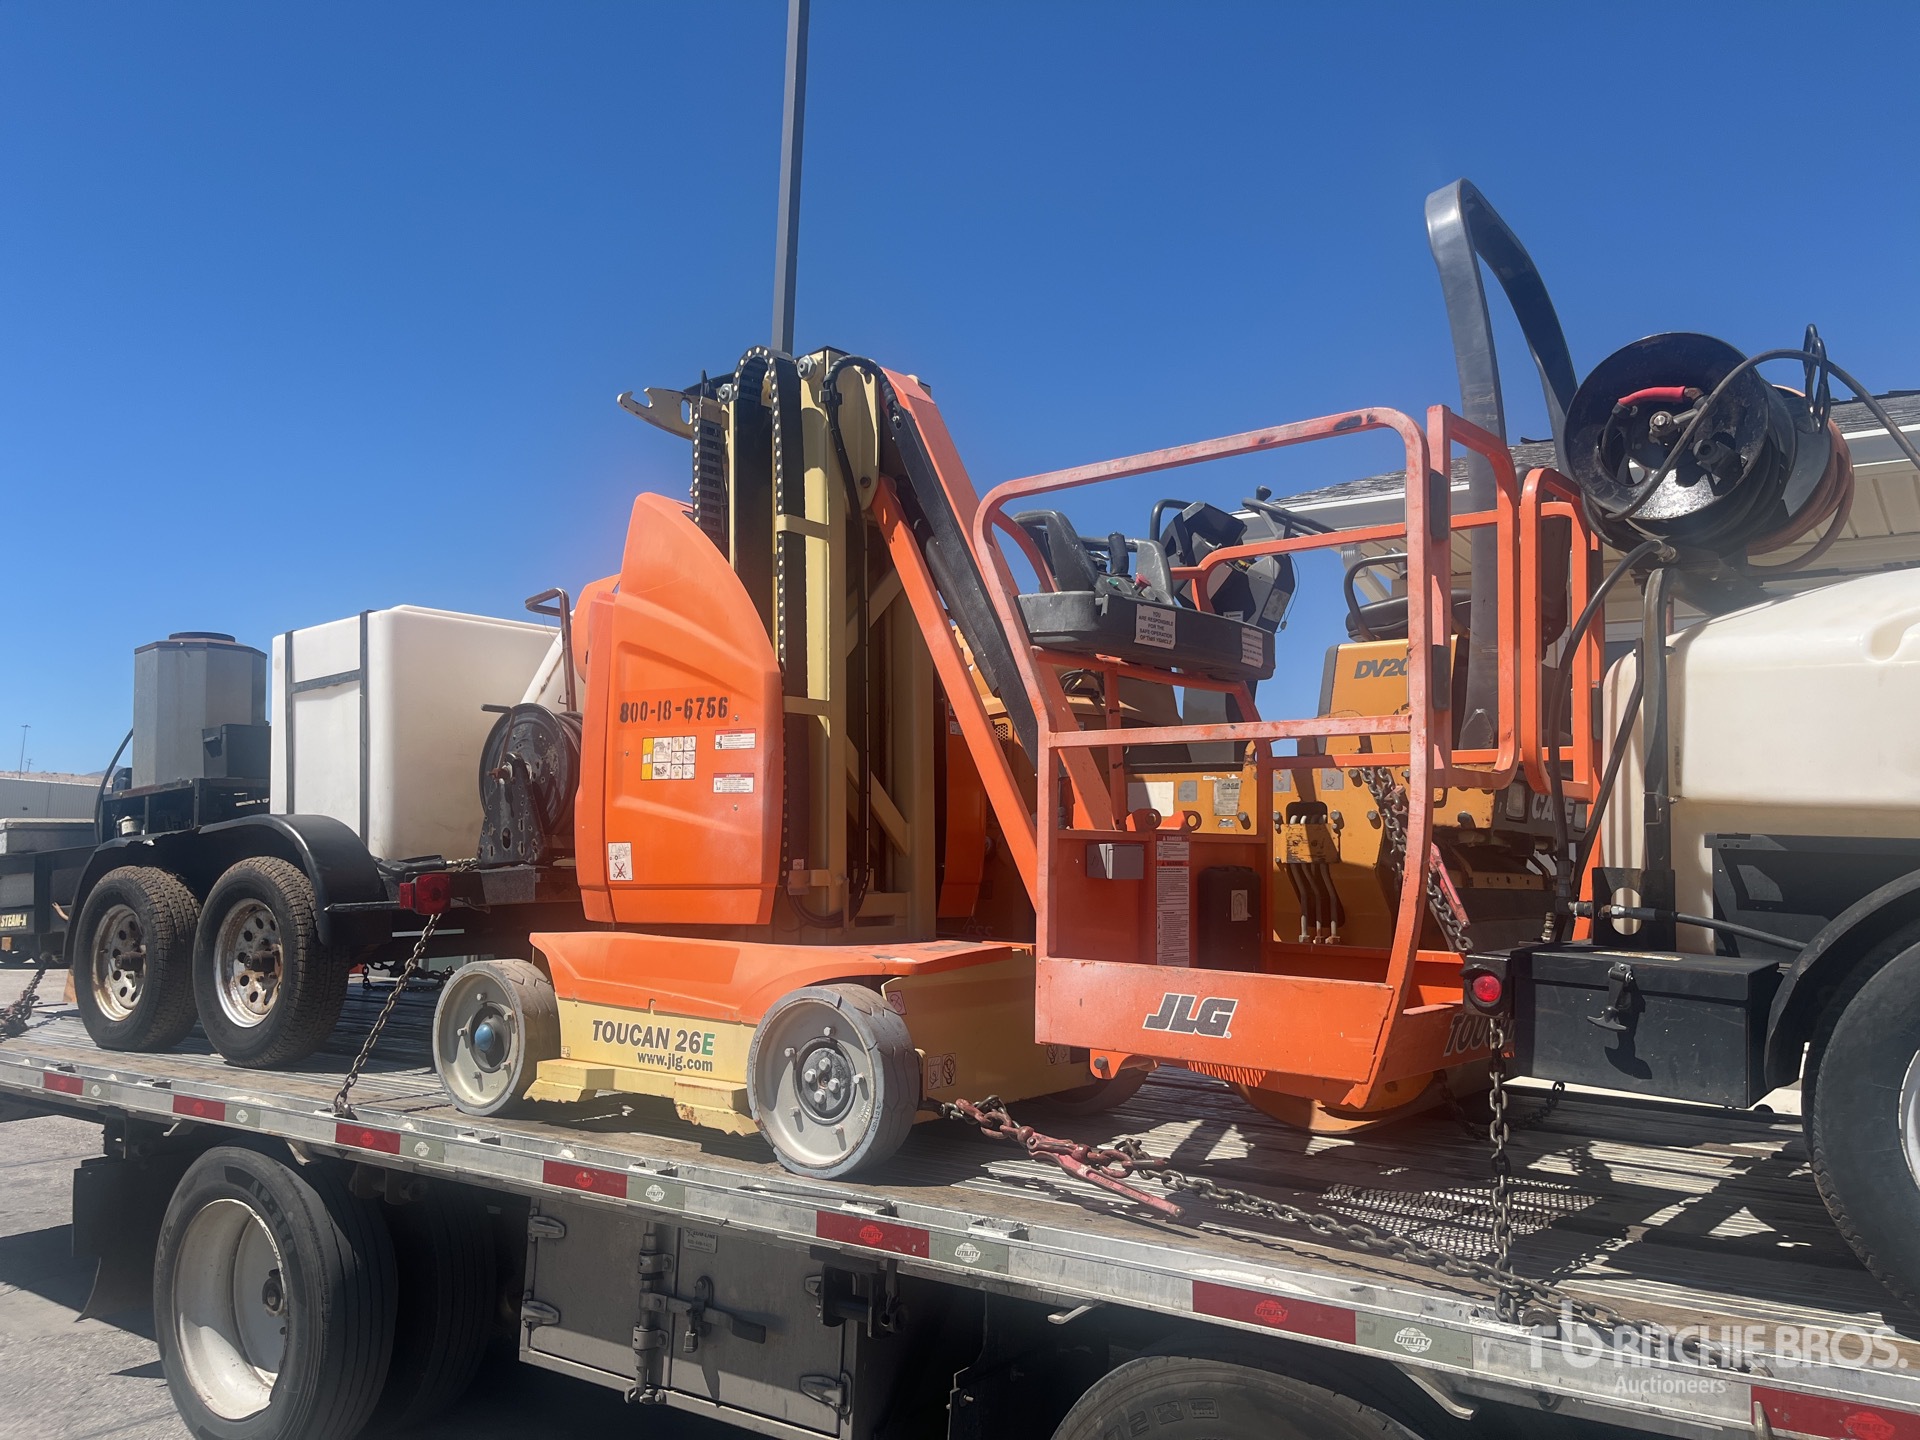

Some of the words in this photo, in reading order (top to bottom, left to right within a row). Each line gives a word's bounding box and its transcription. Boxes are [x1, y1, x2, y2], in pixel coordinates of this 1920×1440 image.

[619, 696, 728, 724] 800-18-6756
[1531, 792, 1575, 824] CAE
[1142, 992, 1239, 1039] JLG
[592, 1020, 671, 1050] TOUCAN
[674, 1029, 716, 1056] 26E
[637, 1052, 713, 1072] www.jlg.com
[1396, 1335, 1431, 1347] UTILITY
